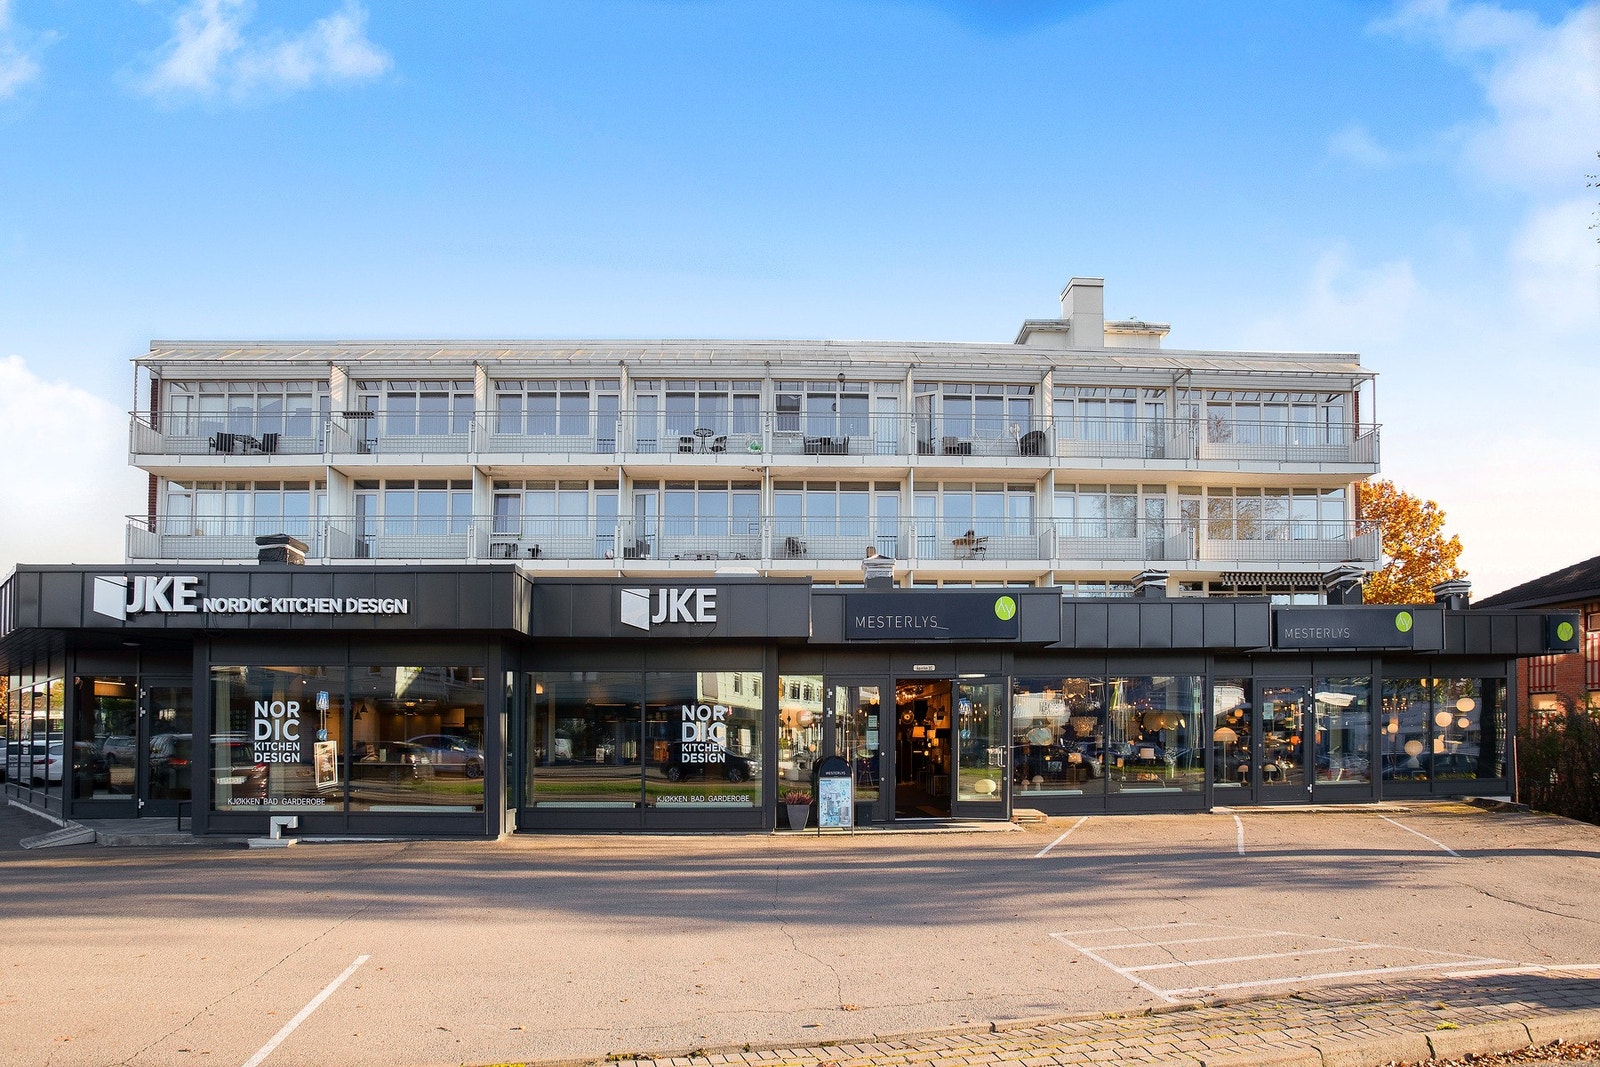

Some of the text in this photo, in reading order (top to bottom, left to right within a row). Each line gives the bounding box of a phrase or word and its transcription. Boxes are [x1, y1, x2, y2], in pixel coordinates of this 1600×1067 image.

[126, 576, 198, 613] JKE
[202, 598, 408, 614] NORDIC KITCHEN DESIGN
[651, 588, 717, 624] JKE
[855, 615, 938, 629] MESTERLYS
[1284, 627, 1351, 639] MESTERLYS
[254, 701, 300, 718] NOR
[682, 705, 725, 721] NOR
[254, 719, 300, 741] DIC
[682, 722, 725, 742] DIC
[254, 742, 300, 751] KITCHEN
[681, 743, 726, 752] KITCHEN
[254, 752, 300, 763] DESIGN
[681, 753, 726, 763] DESIGN
[656, 795, 688, 803] KJØKKEN
[690, 795, 705, 803] BAD
